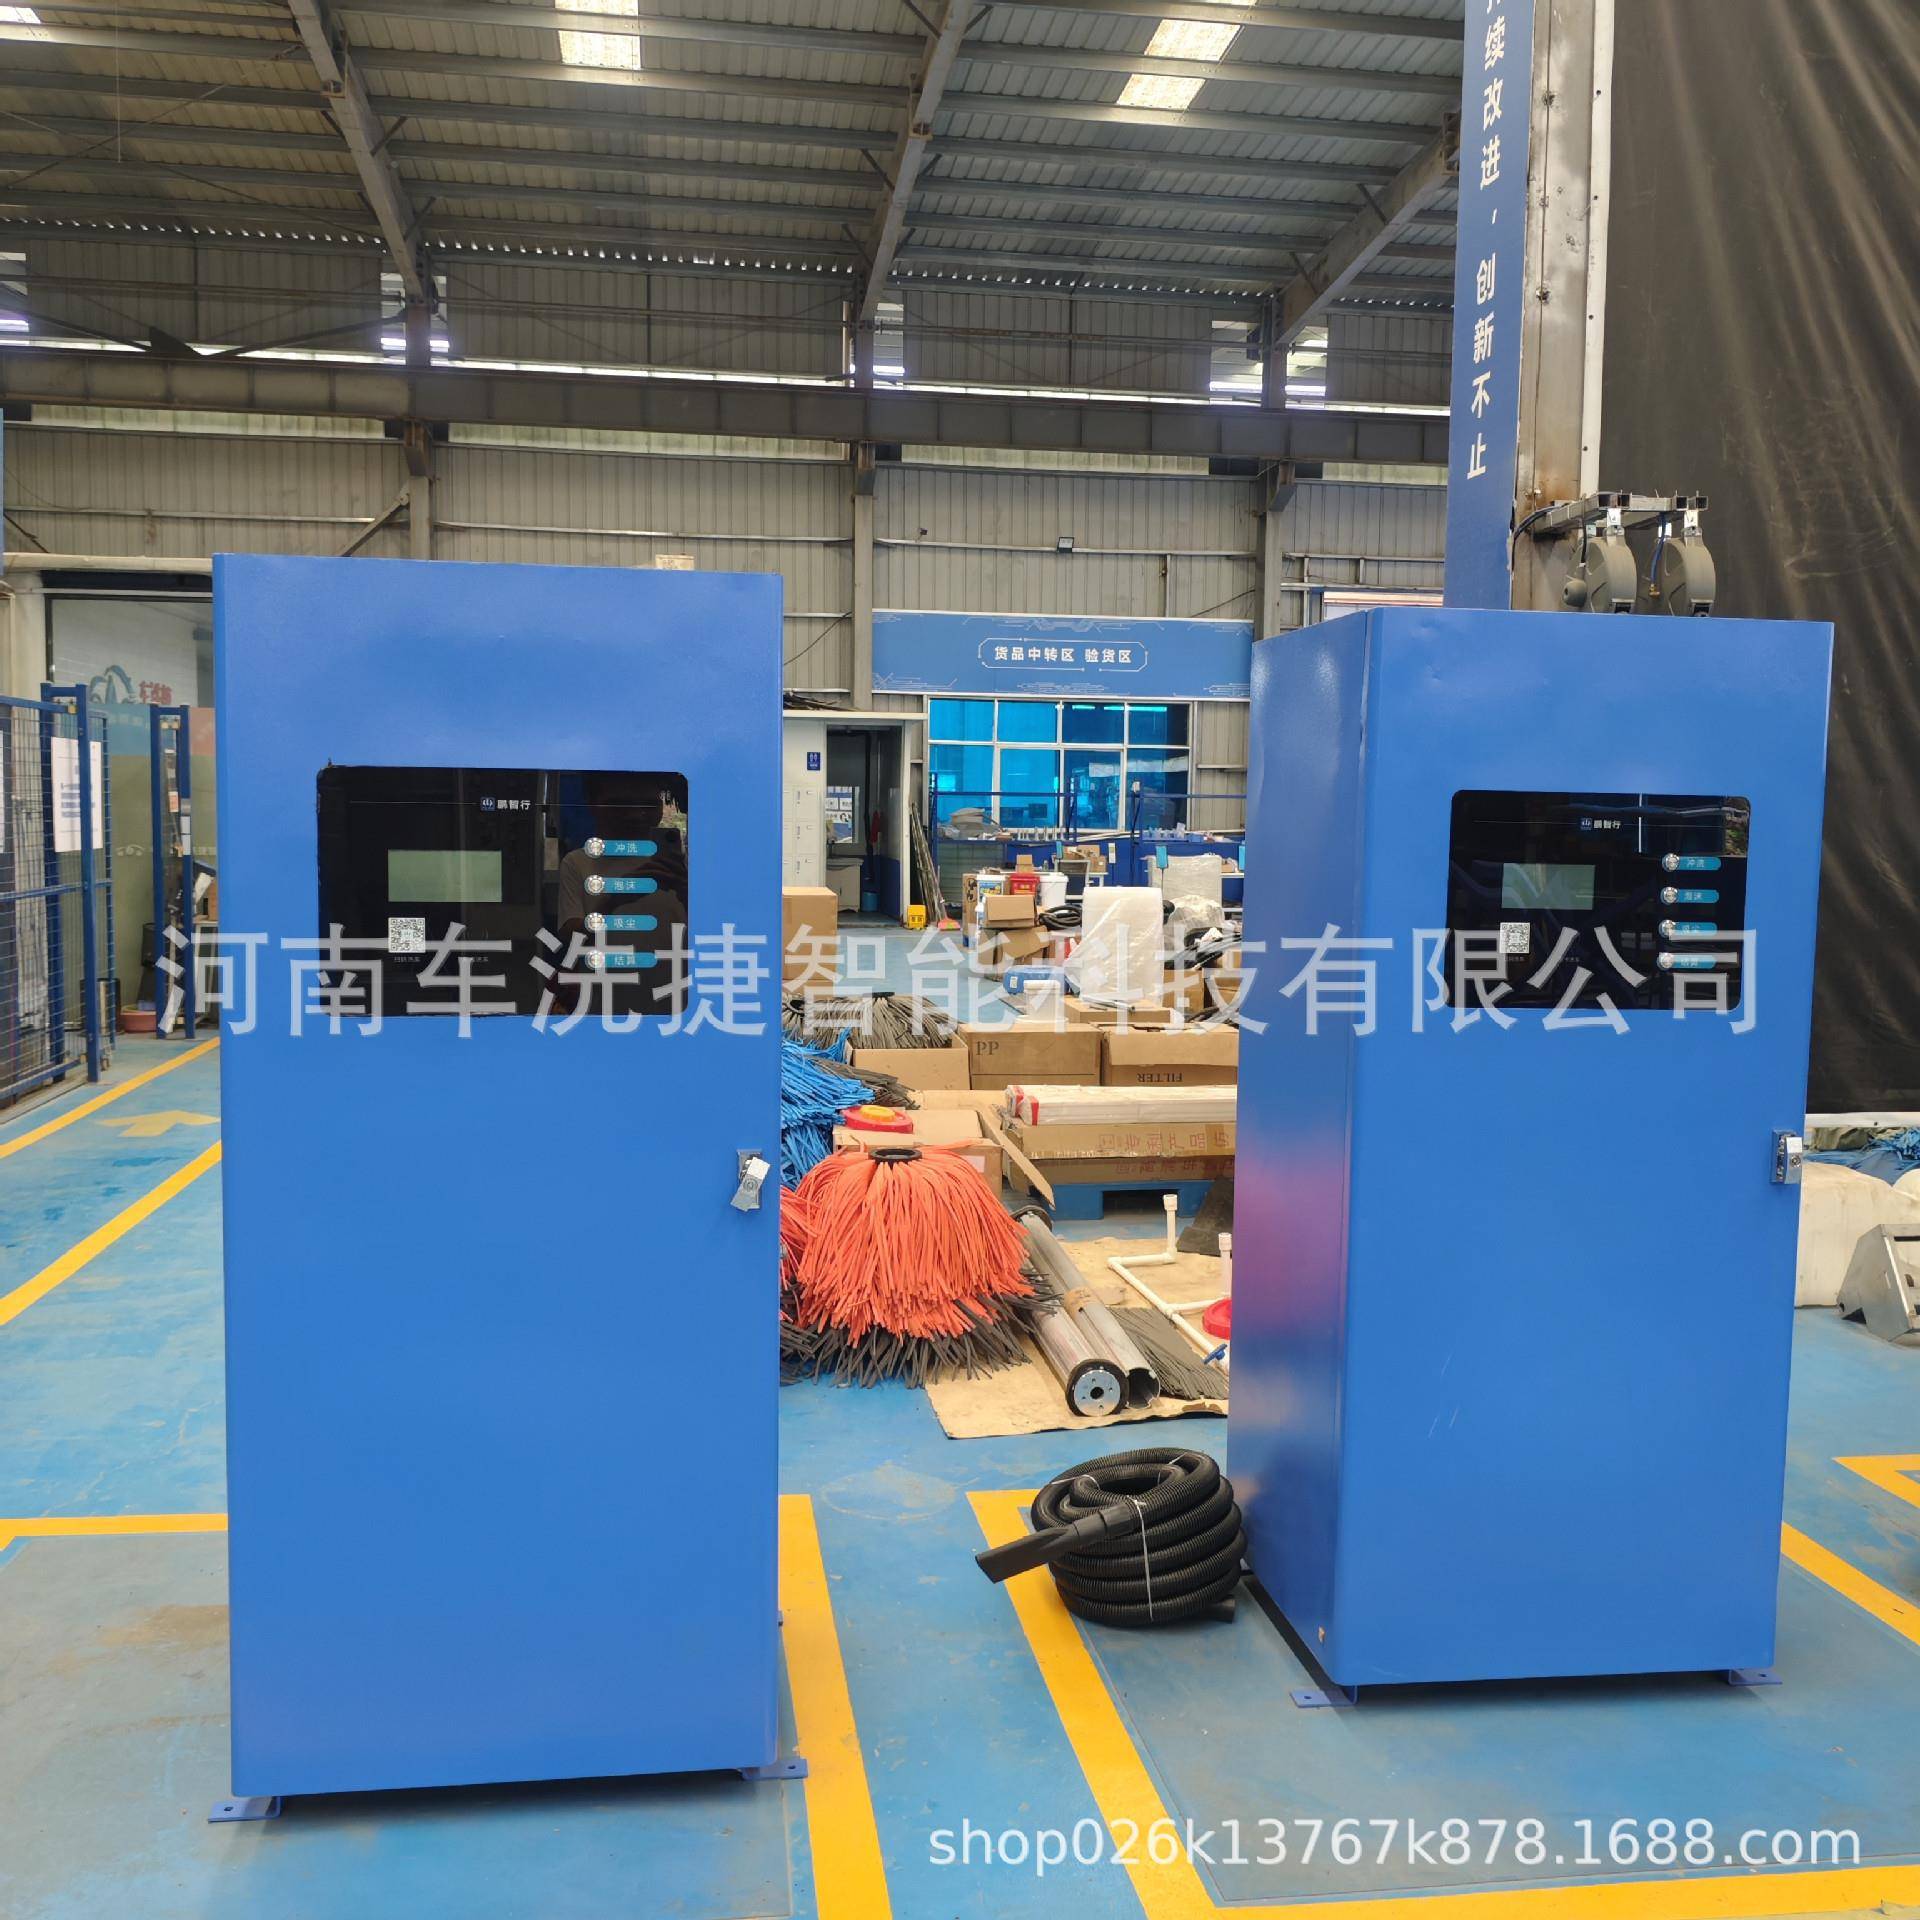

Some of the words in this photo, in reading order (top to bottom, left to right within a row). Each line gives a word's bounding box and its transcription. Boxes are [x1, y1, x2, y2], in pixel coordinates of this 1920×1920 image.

[994, 646, 1075, 663] 货品中转区
[1084, 648, 1133, 664] 验货区
[614, 842, 639, 854] 冲洗
[613, 879, 637, 891] 泡沫
[975, 1040, 1000, 1056] PP
[1136, 1072, 1184, 1083] FILTER
